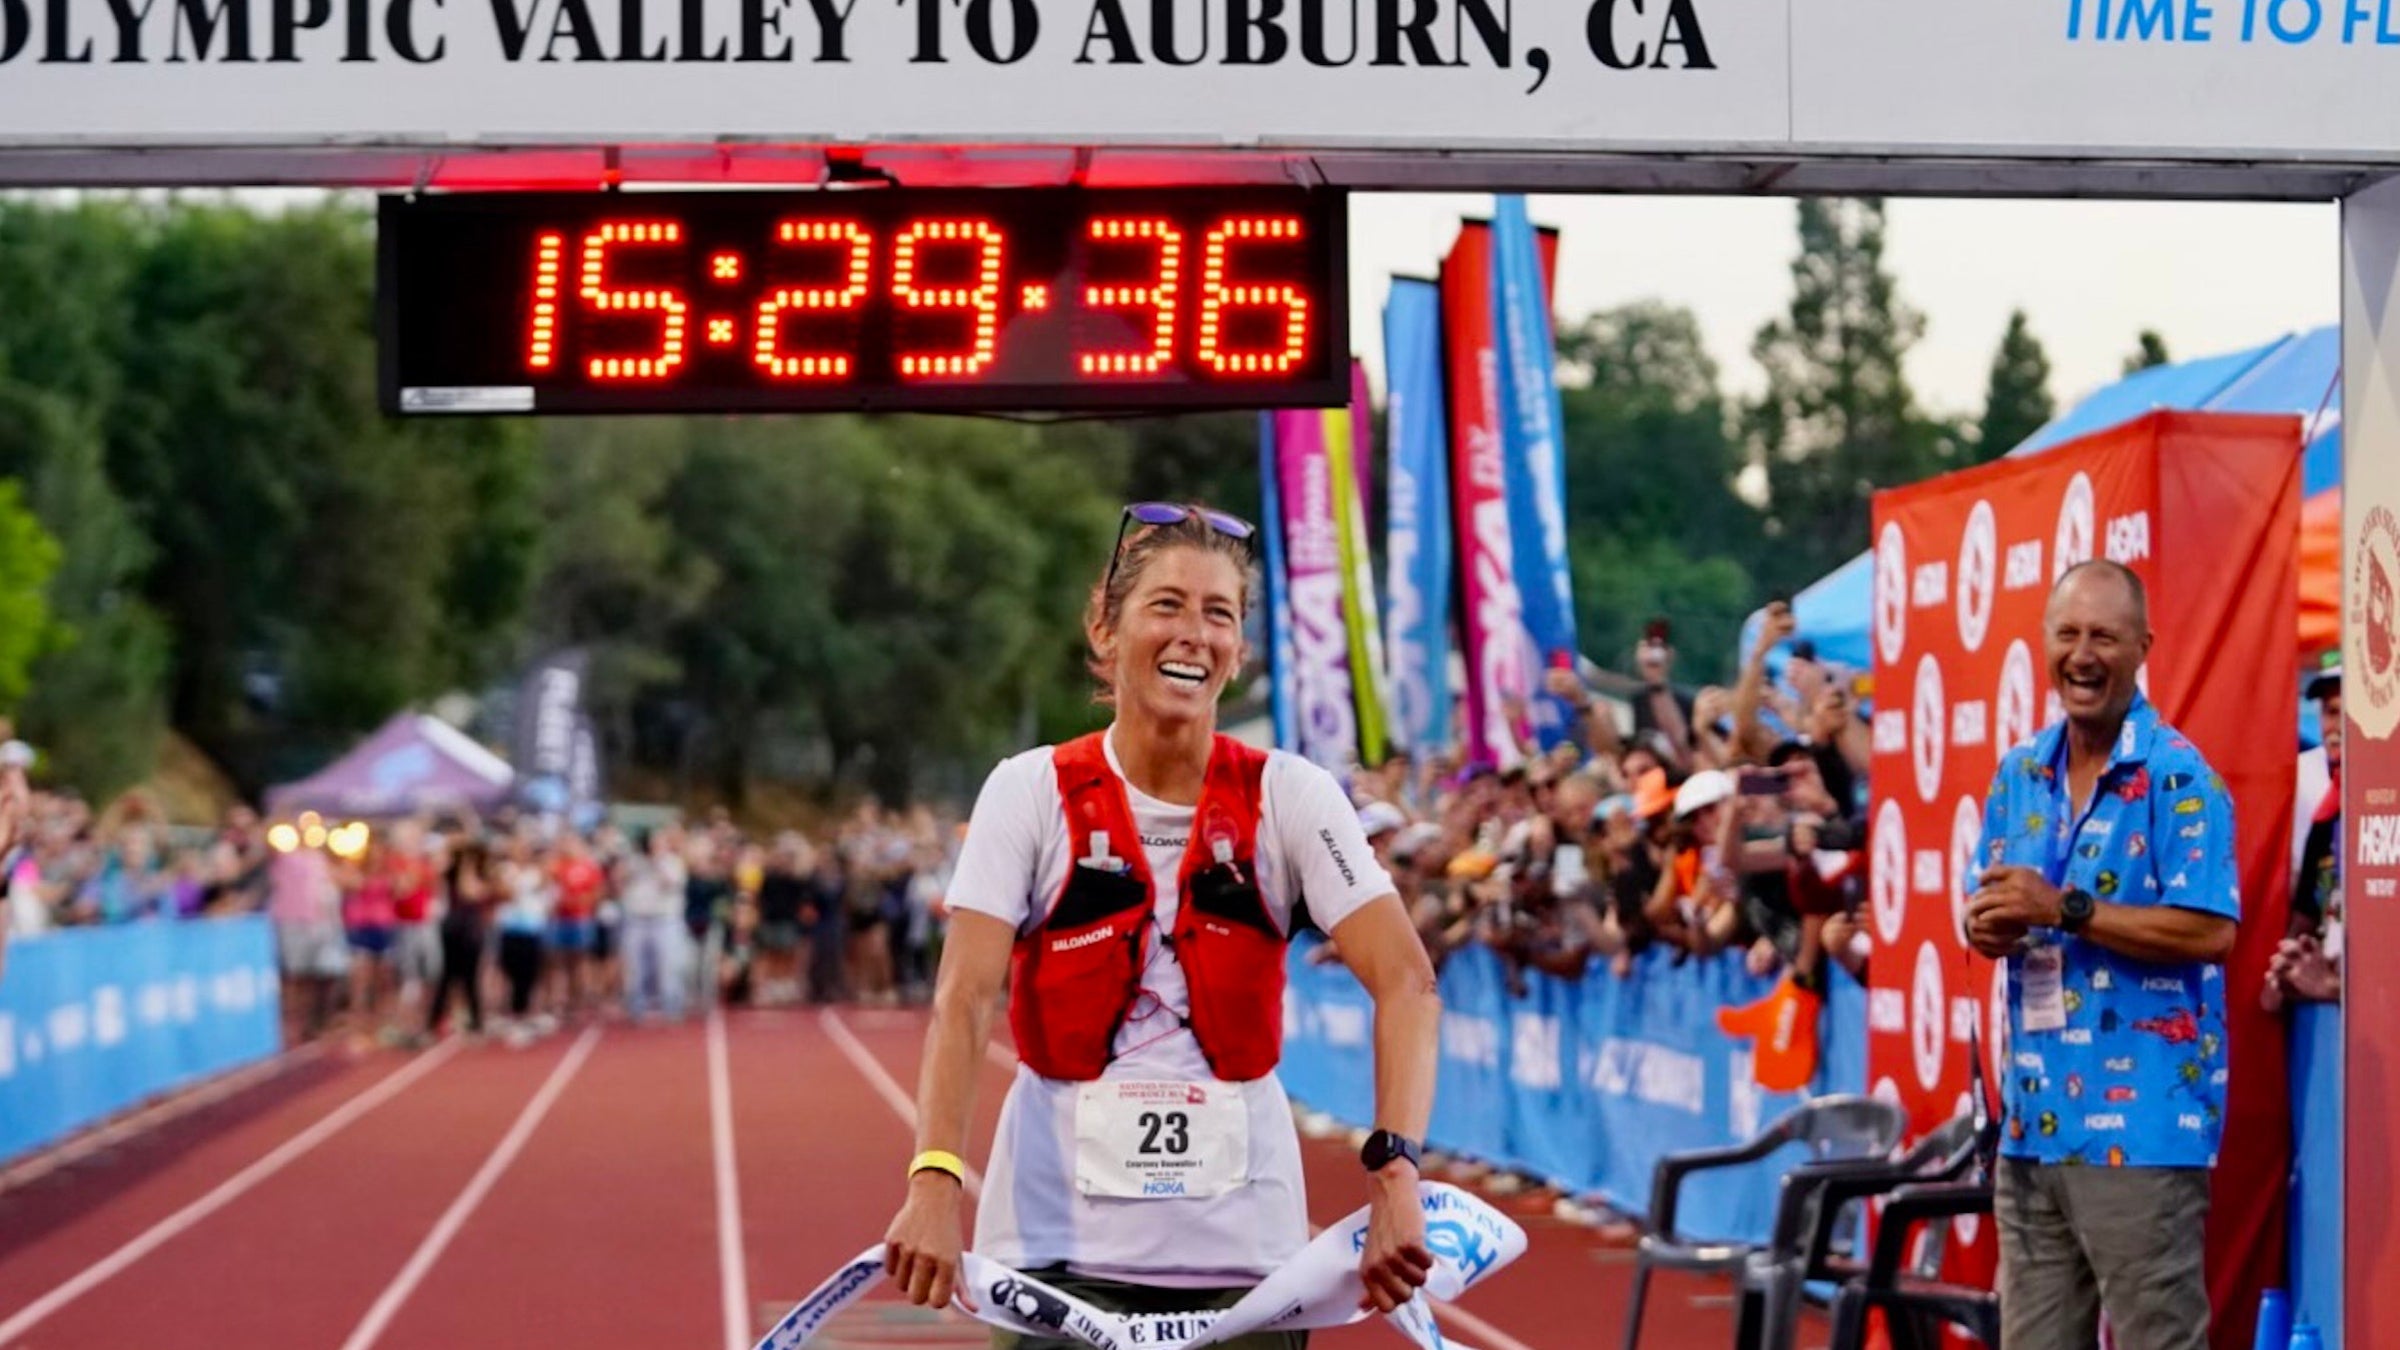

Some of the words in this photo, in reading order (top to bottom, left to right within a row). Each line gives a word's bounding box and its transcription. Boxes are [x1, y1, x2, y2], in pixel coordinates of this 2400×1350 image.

[2065, 0, 2214, 42] TIME
[2238, 0, 2322, 44] TO
[488, 0, 859, 63] VALLEY
[896, 0, 1041, 65] TO
[1073, 0, 1551, 95] AUBURN,
[1586, 0, 1718, 70] CA
[2105, 511, 2149, 565] HOKA
[1140, 836, 1189, 847] ALOMO
[1318, 828, 1357, 887] SALOMON
[1052, 925, 1114, 951] SALOMON
[1138, 1111, 1190, 1155] 23
[1143, 1182, 1185, 1194] HOKA
